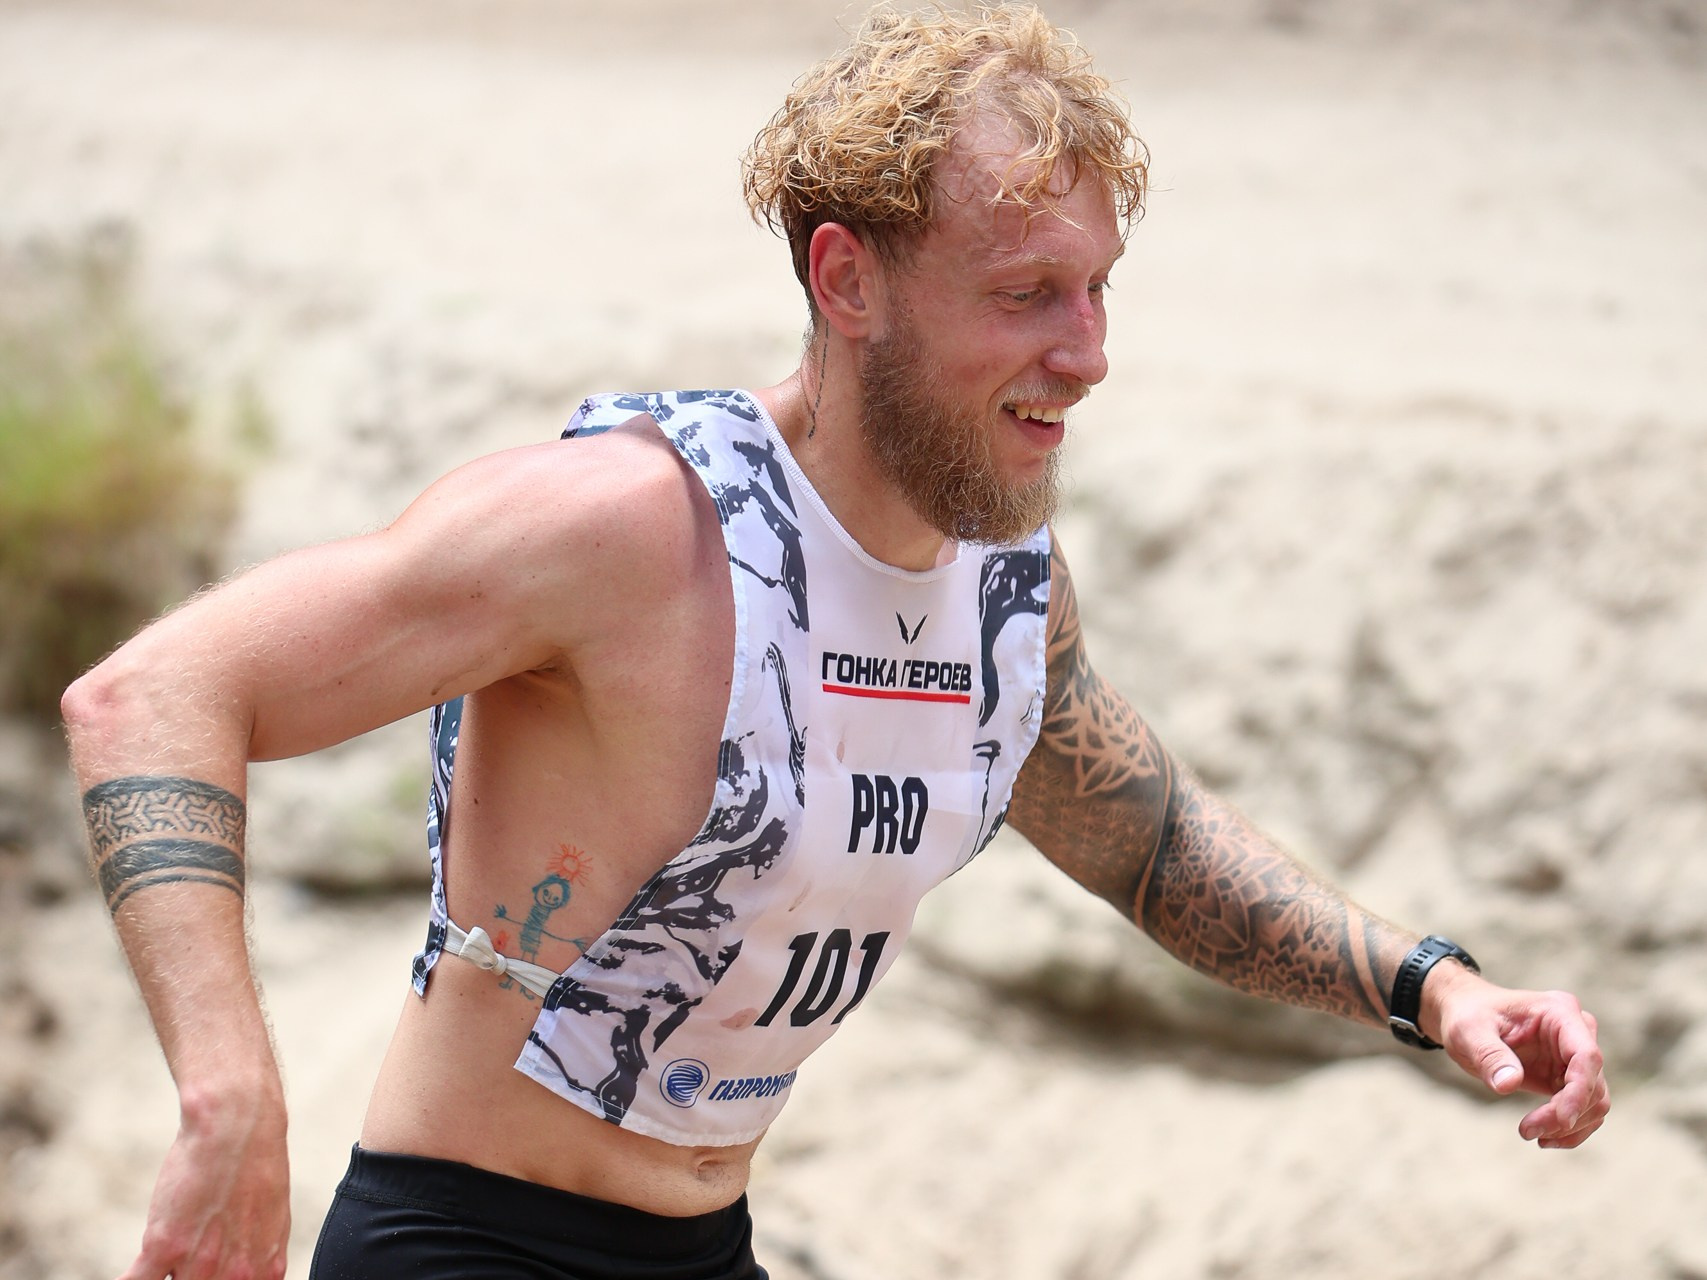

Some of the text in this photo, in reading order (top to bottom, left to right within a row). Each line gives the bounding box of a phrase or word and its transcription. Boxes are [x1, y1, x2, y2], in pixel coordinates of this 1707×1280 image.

[822, 651, 972, 691] ГОНКА ГЕРОЕВ
[847, 774, 928, 854] PRO
[753, 928, 890, 1027] 101
